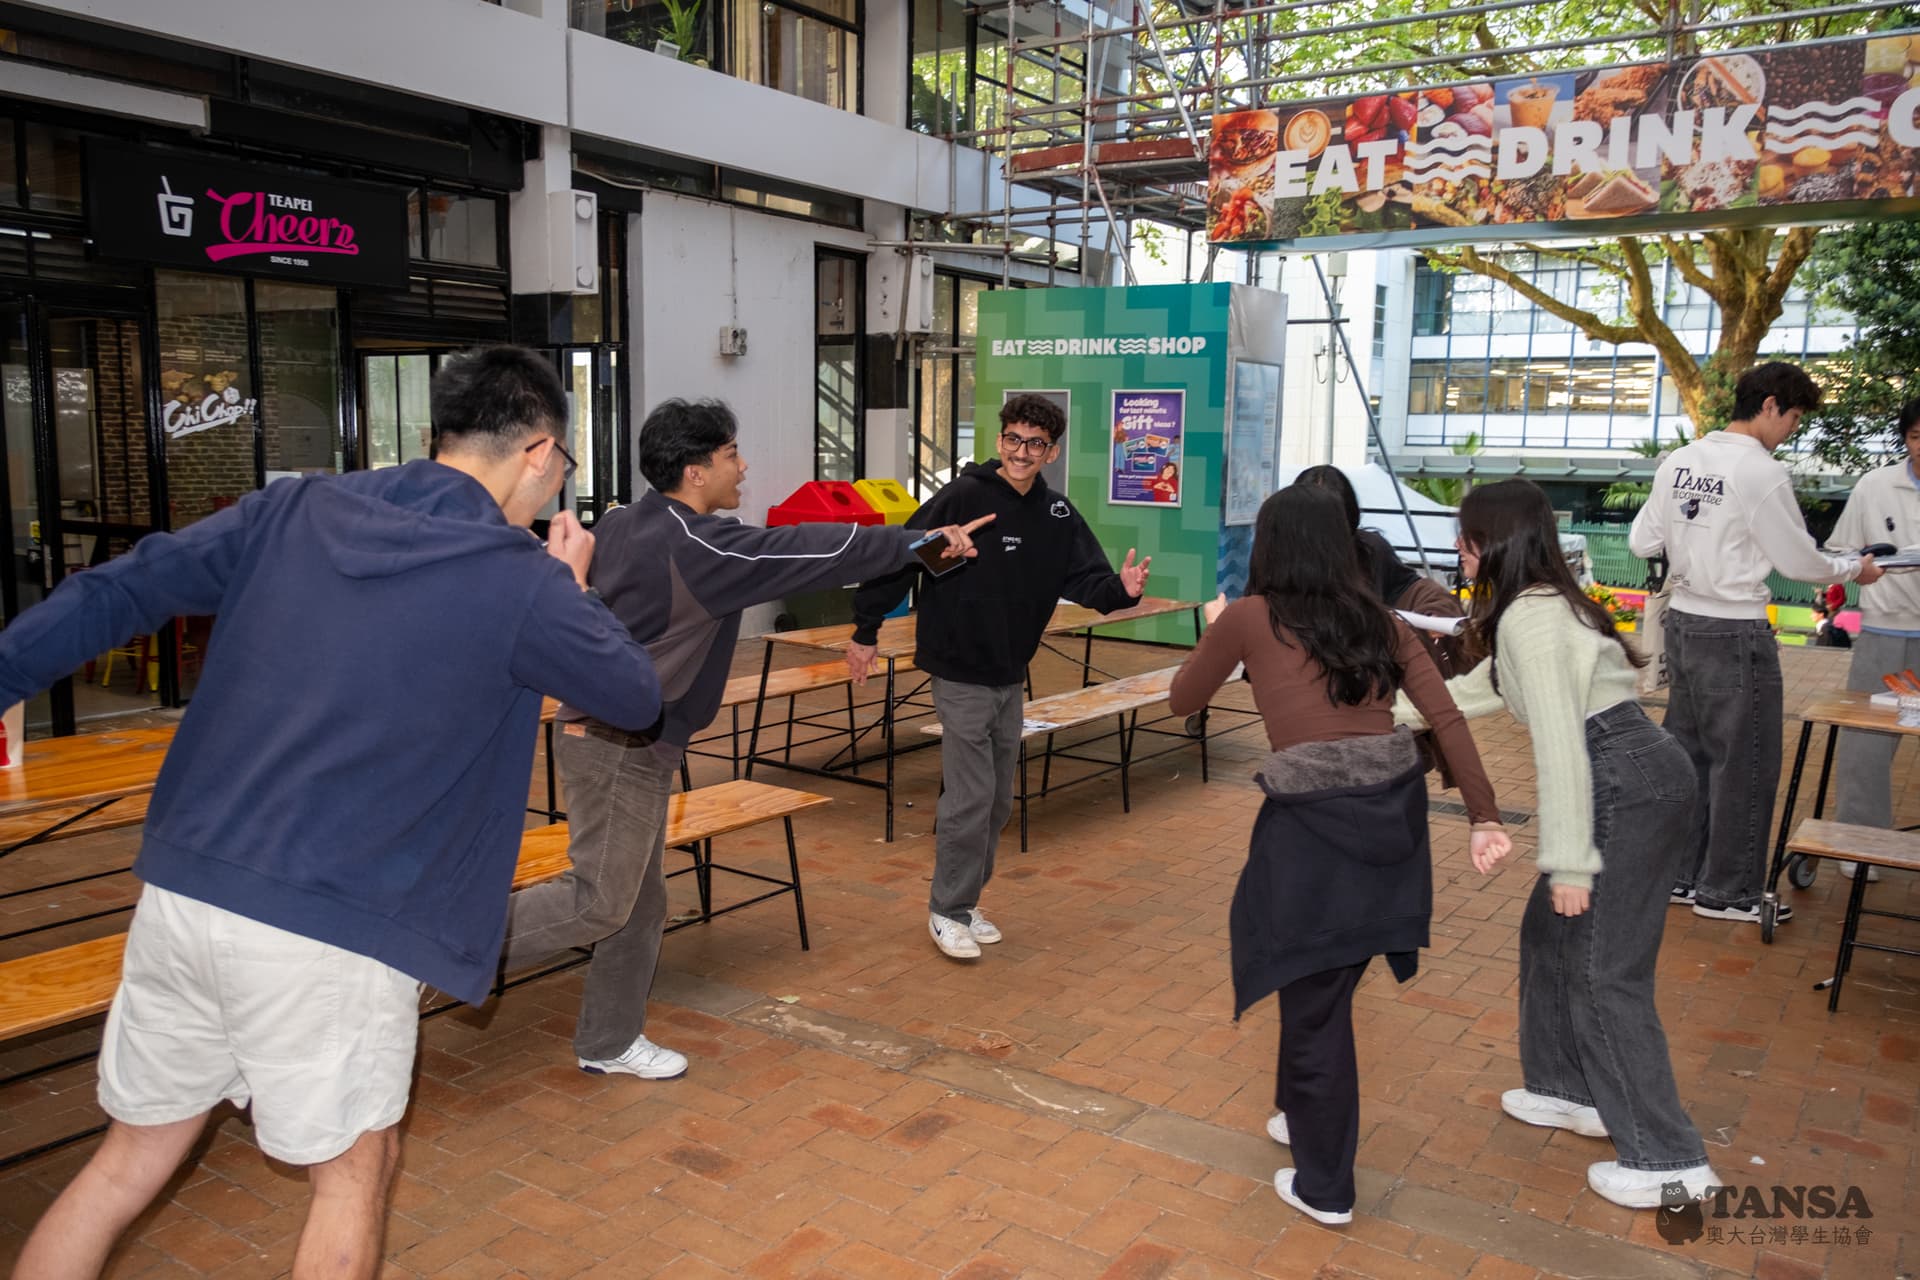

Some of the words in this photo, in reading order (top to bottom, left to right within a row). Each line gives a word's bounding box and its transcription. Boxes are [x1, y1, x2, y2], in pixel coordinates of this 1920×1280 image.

[1274, 139, 1398, 199] EAT
[1496, 103, 1761, 181] DRINK
[267, 194, 312, 212] TEAPEI
[270, 255, 293, 265] SINCE
[992, 339, 1026, 356] EAT
[1055, 338, 1118, 355] DRINK
[1149, 336, 1206, 355] SHOP
[1123, 397, 1159, 408] Looking
[162, 399, 201, 432] Chi
[1121, 415, 1154, 430] Gift
[1673, 467, 1724, 496] TANSA
